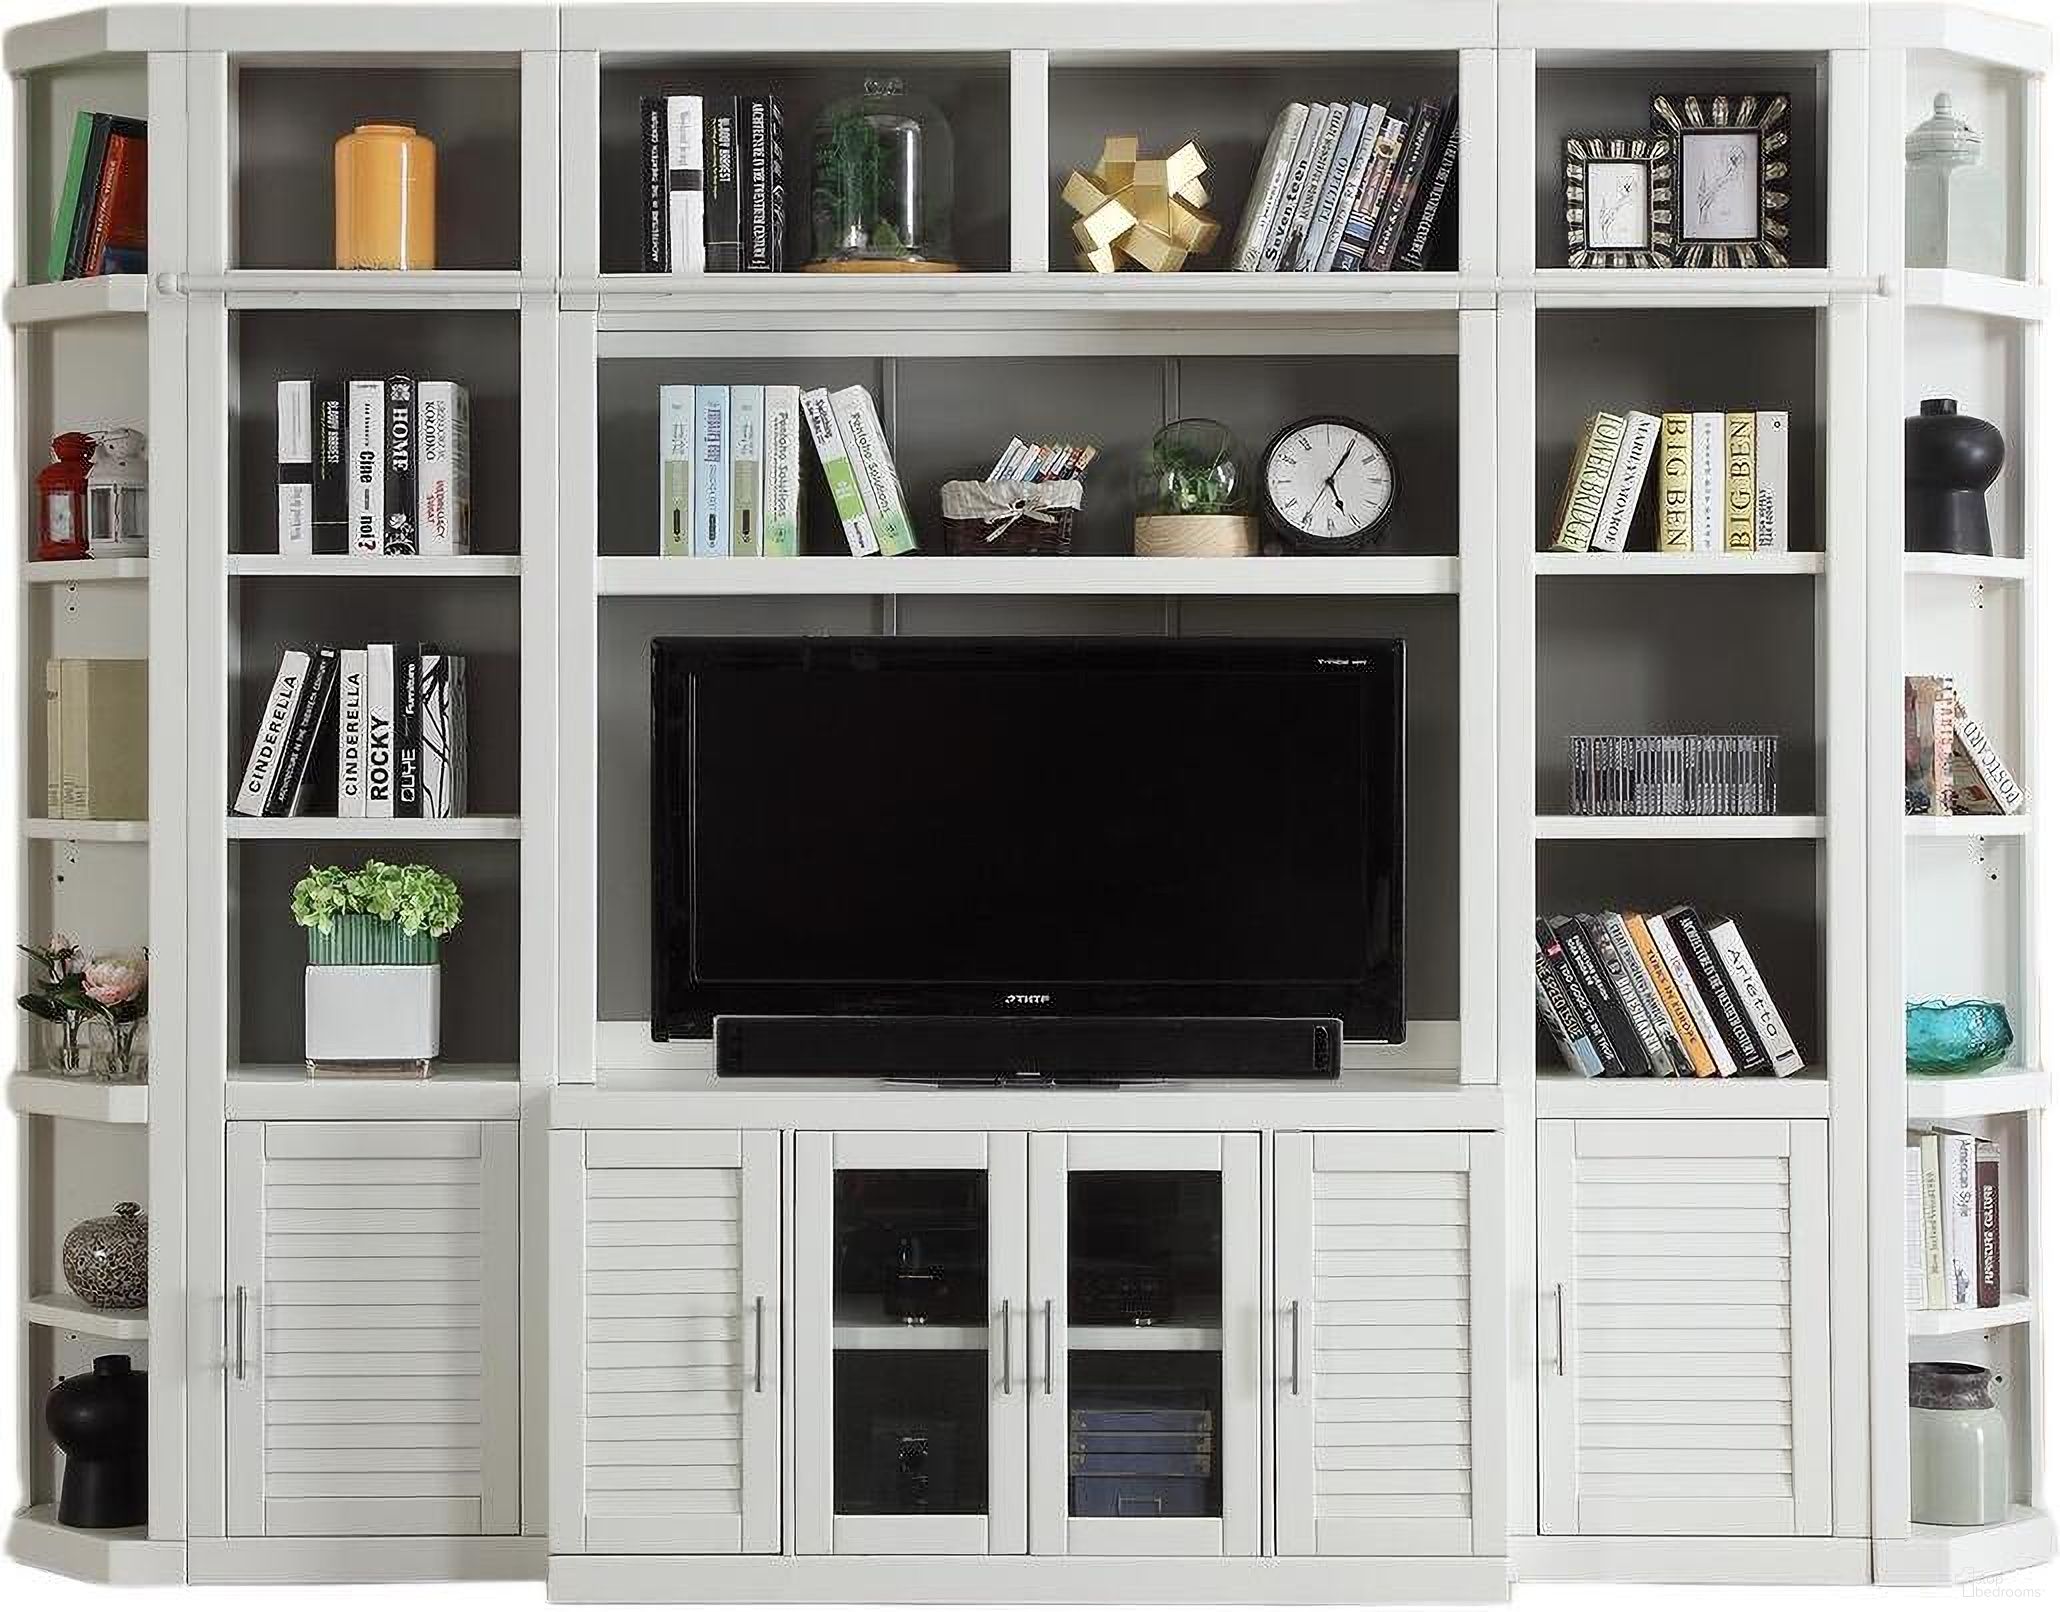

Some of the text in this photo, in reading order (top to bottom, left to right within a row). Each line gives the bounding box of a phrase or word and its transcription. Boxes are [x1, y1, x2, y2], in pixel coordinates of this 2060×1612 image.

[359, 450, 376, 484] Cine
[392, 408, 408, 472] HOME
[1561, 414, 1625, 550] TOWER BRIDGE
[1603, 419, 1653, 546] MARILYN MONROE
[1666, 418, 1687, 547] BIG BEN
[1730, 420, 1752, 549] BIG BEN
[248, 675, 298, 794] CINDERELLA
[345, 673, 361, 796] CINDERELLA
[370, 714, 389, 801] ROCKY
[1963, 721, 2019, 804] POSTCARD
